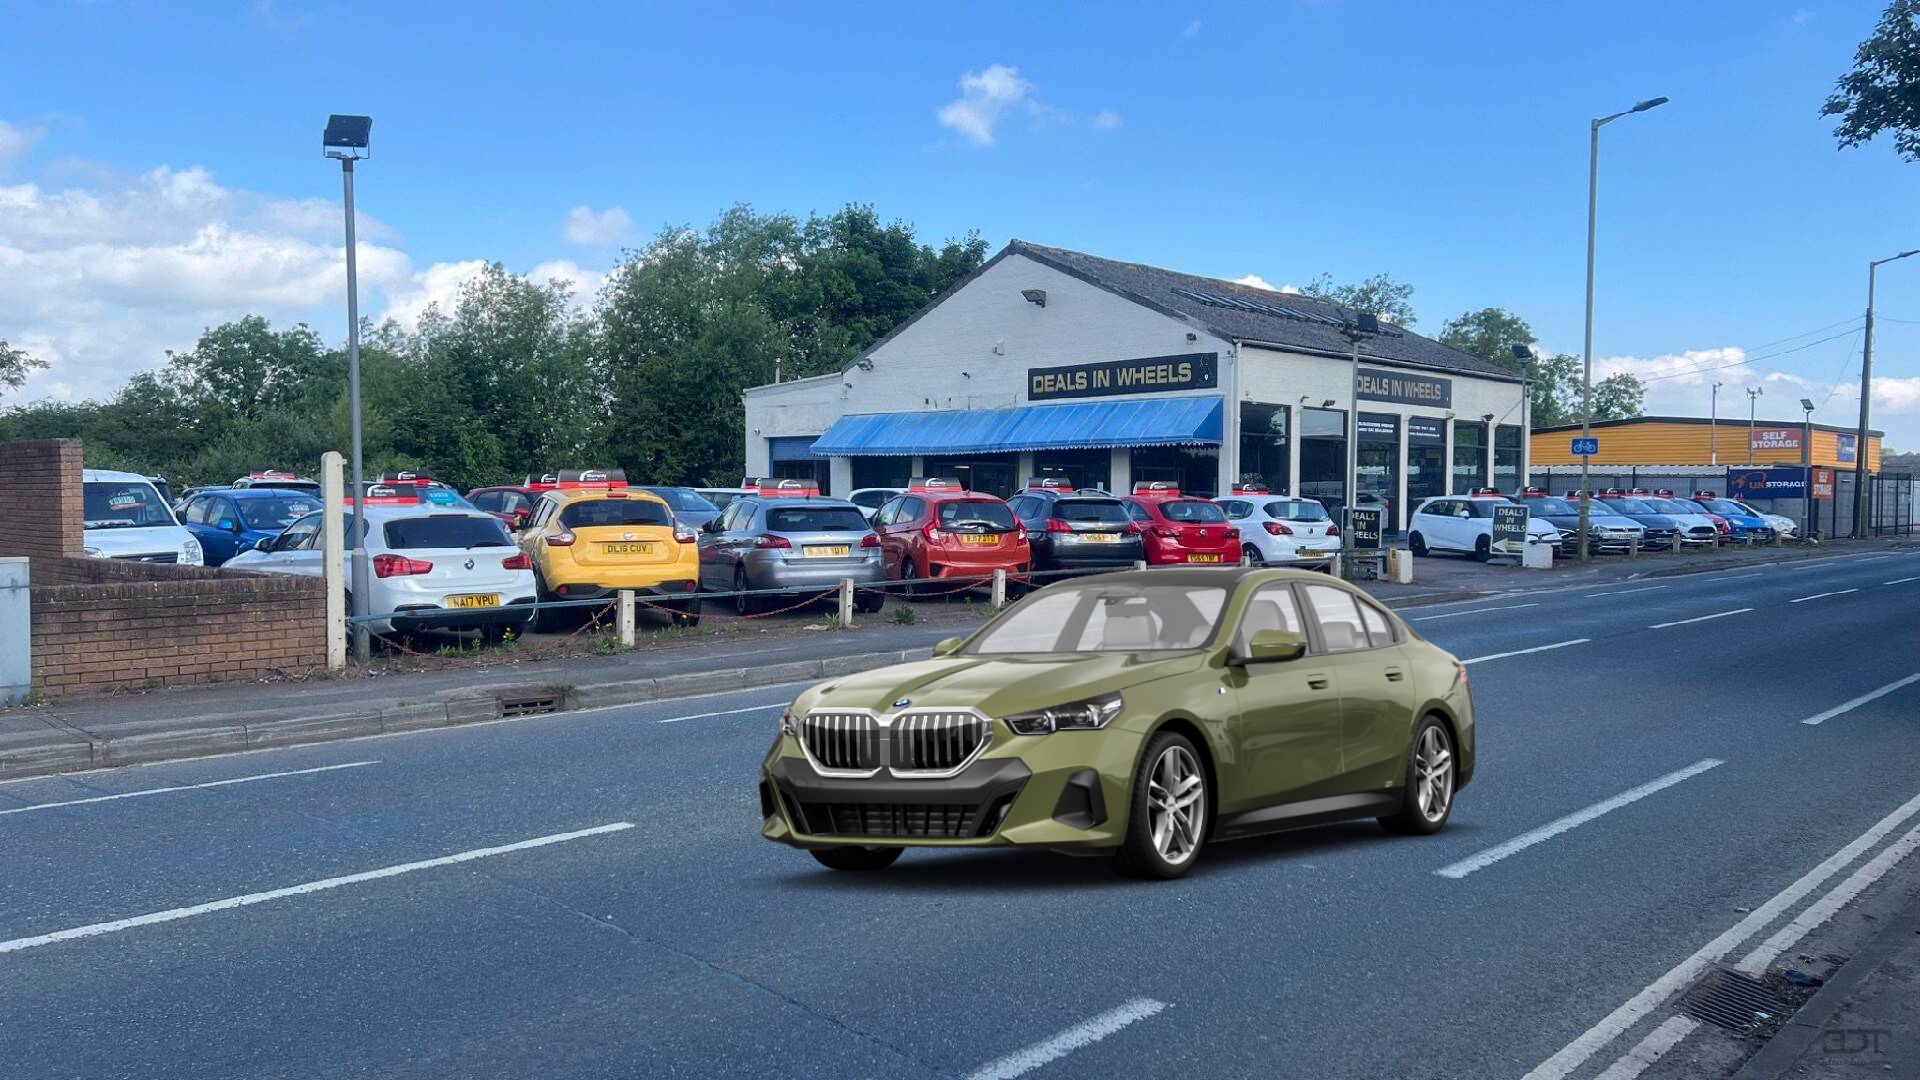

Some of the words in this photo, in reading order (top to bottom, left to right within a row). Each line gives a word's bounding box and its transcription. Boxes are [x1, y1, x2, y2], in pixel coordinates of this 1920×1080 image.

[1032, 371, 1087, 393] DEALS
[1092, 369, 1110, 388] IN
[1116, 362, 1192, 386] WHEELS
[1357, 375, 1389, 396] DEALS
[1391, 379, 1403, 397] IN
[1404, 380, 1442, 400] WHEELS
[1762, 431, 1788, 440] SELF
[1751, 439, 1799, 449] STORAGE
[1498, 508, 1524, 517] DEALS
[1357, 520, 1367, 530] IN
[1506, 516, 1515, 524] IN
[1494, 523, 1526, 533] WHEELS
[1353, 530, 1379, 540] HEELS
[453, 597, 473, 608] NA17
[475, 594, 494, 606] VPU
